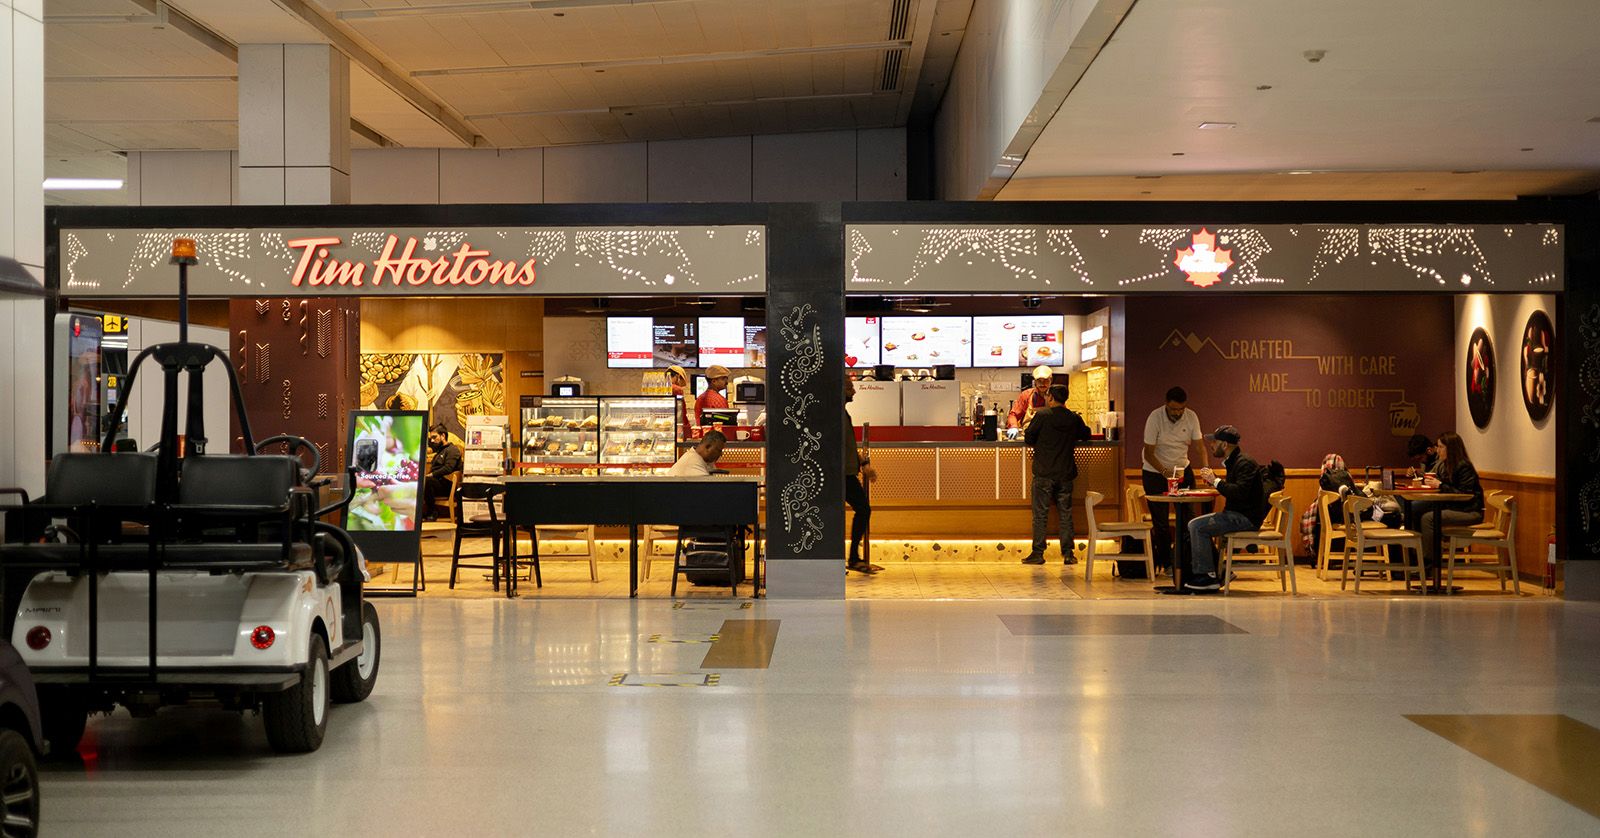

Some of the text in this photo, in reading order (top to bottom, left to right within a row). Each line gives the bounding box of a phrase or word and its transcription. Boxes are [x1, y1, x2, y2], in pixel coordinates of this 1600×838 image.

[287, 234, 536, 287] Tim Hortons
[1230, 340, 1293, 359] CRAFTED
[1317, 355, 1396, 375] WITH CARE
[1249, 373, 1289, 392] MADE
[1305, 388, 1375, 408] TO ORDER
